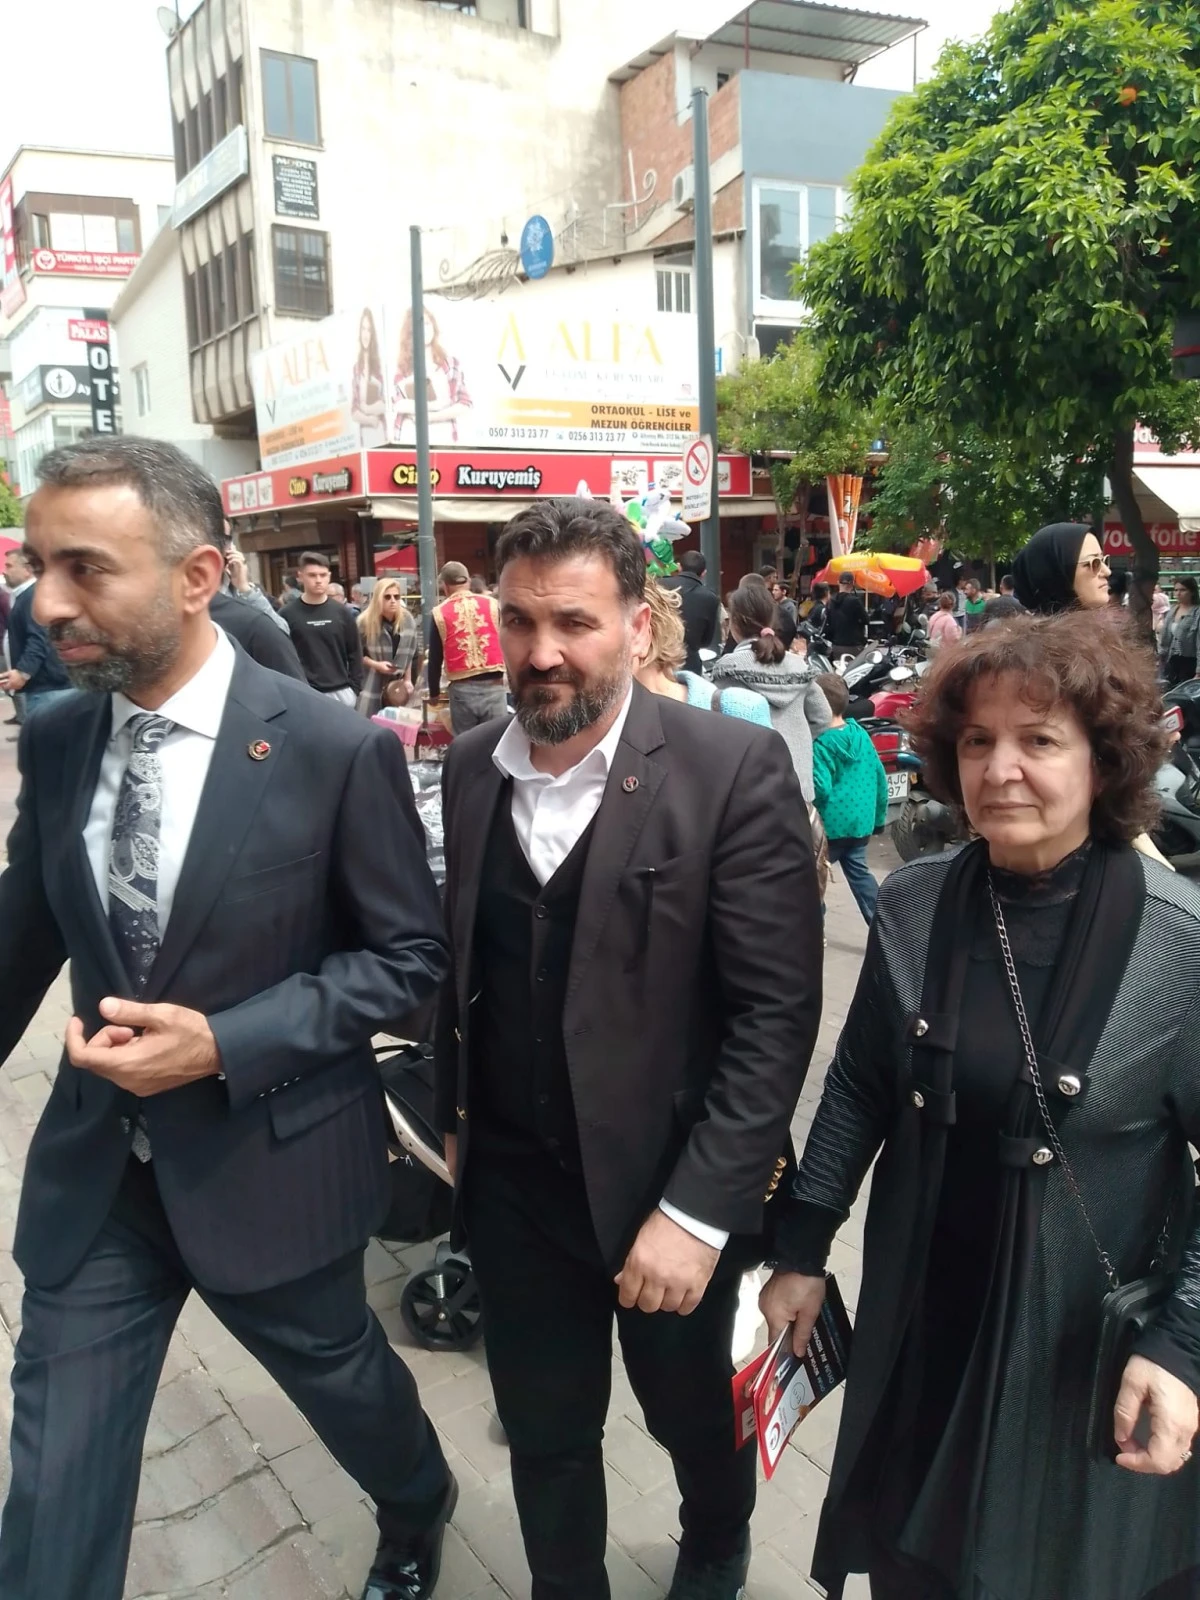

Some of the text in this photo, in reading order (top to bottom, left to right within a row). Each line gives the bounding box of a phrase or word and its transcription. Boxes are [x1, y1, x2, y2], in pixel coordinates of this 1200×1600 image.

[71, 324, 107, 340] PALAS
[550, 319, 663, 366] ALFA
[89, 347, 113, 432] OTE
[591, 405, 646, 417] ORTAOKUL
[656, 405, 676, 418] LİSE
[679, 410, 692, 418] ve
[489, 427, 549, 439] 0507 313 23 77
[590, 417, 692, 432] MEZUN ÖĞRENCİLER
[568, 431, 626, 442] 0256 313 23 77
[393, 465, 541, 489] Cio Kuruyemiş
[289, 478, 307, 496] Cino
[1102, 524, 1198, 547] vofone
[824, 1364, 835, 1385] OYUM
